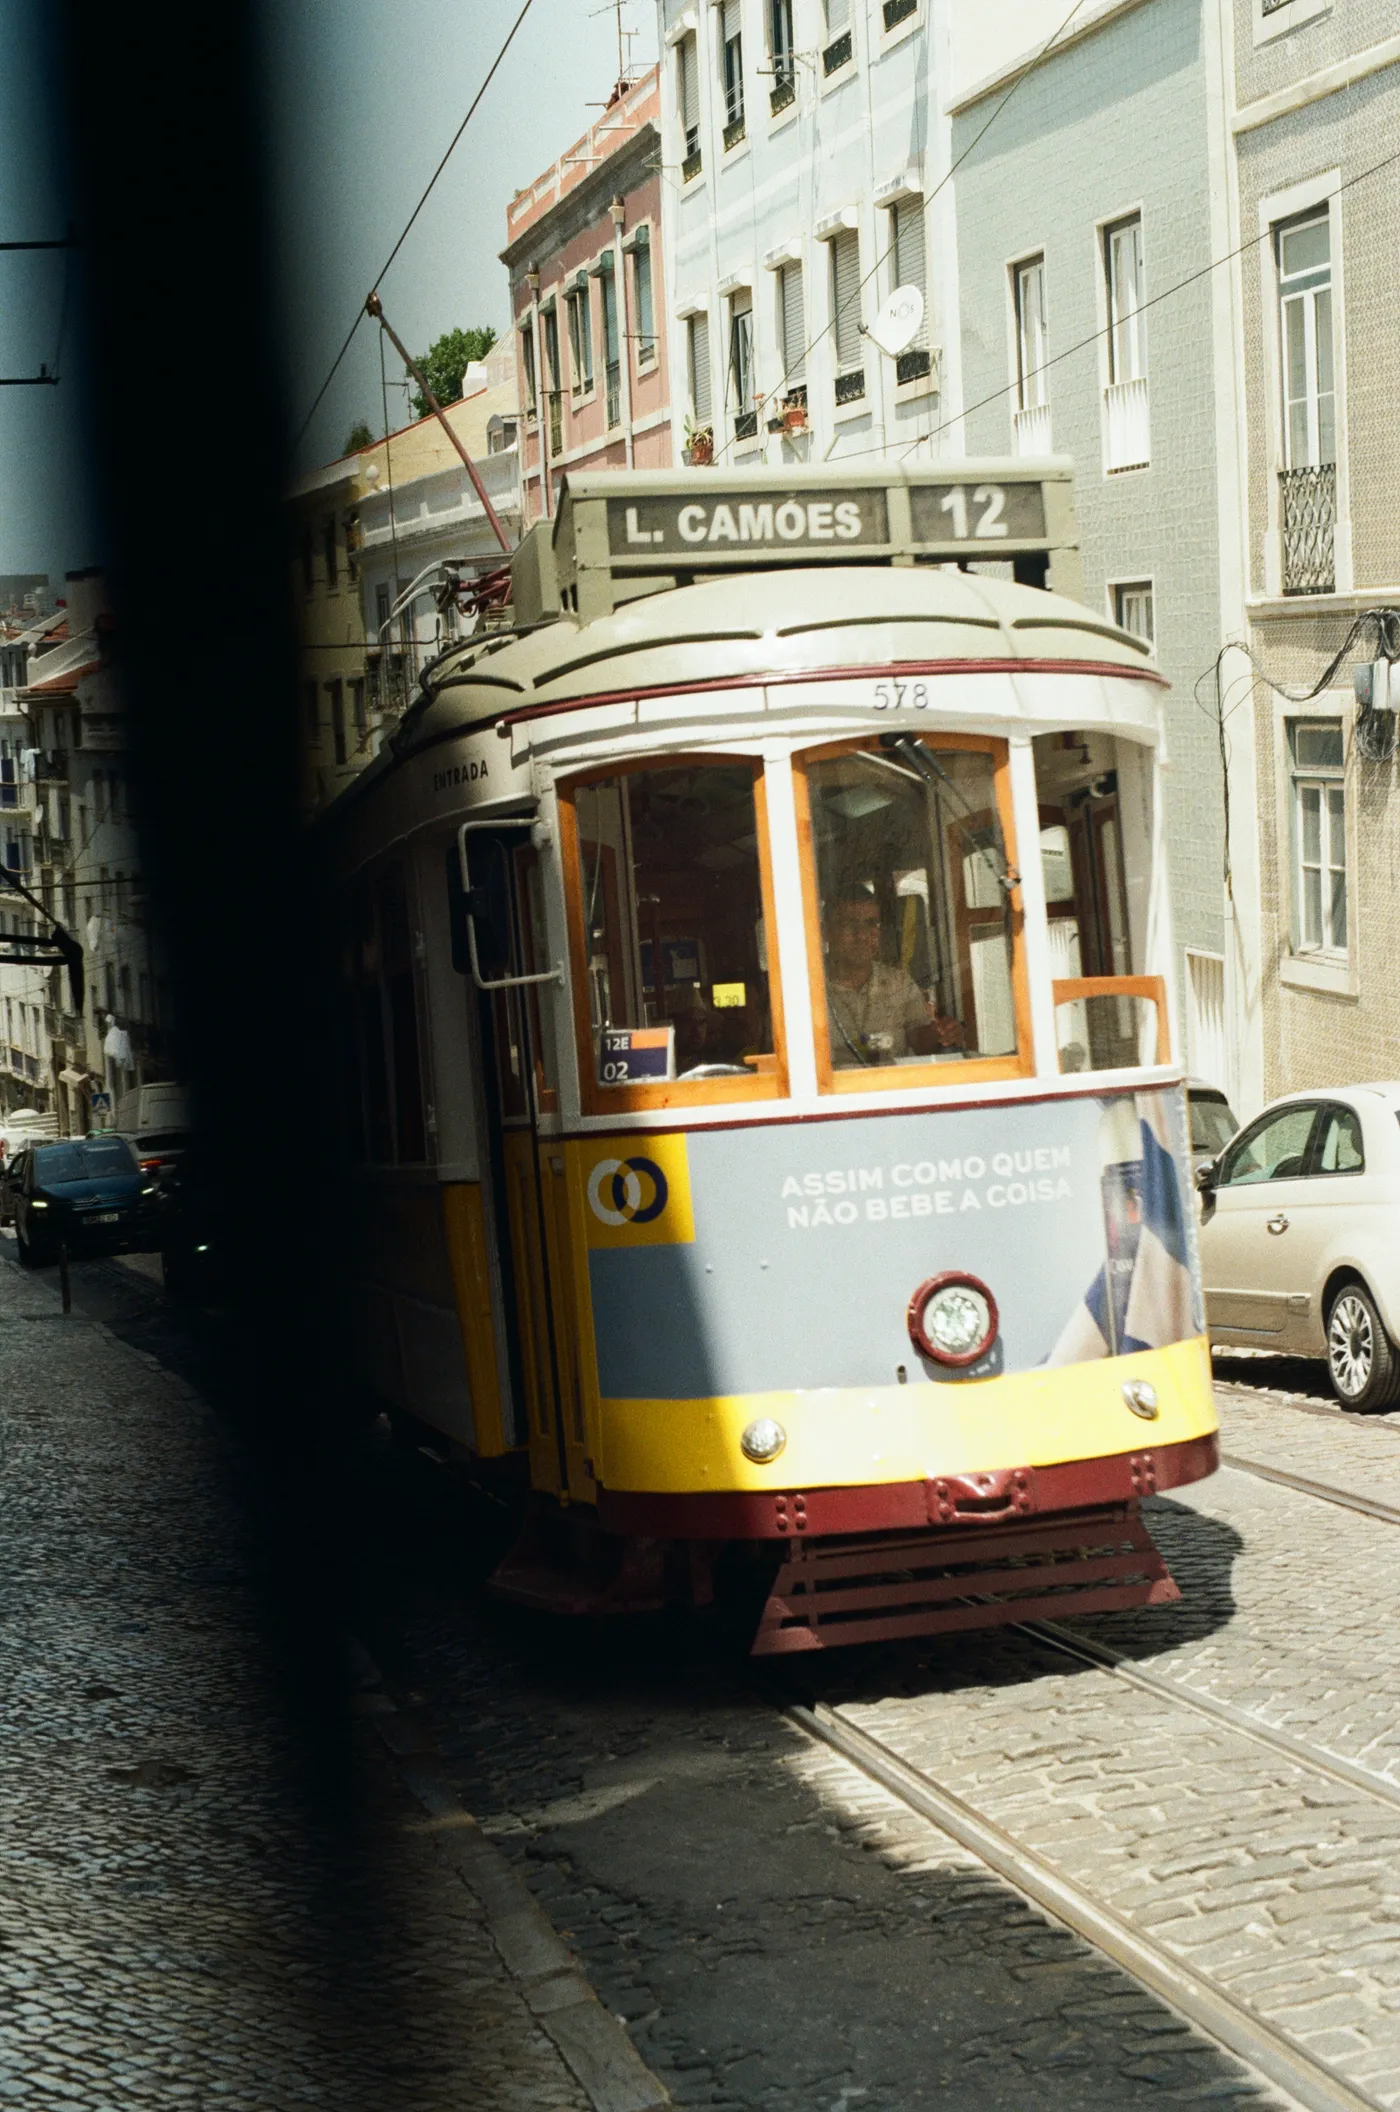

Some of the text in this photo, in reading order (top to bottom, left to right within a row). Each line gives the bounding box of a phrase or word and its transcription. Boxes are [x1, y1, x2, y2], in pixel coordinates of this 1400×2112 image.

[625, 506, 664, 543] L.
[941, 485, 1009, 539] 12
[872, 683, 929, 710] 578
[433, 760, 489, 791] ENTRADA
[605, 1036, 629, 1051] 12E
[605, 1061, 628, 1080] 02
[780, 1146, 1072, 1198] ASSIM COMO QUEM
[786, 1177, 1074, 1229] NÃO BEBE A COISA
